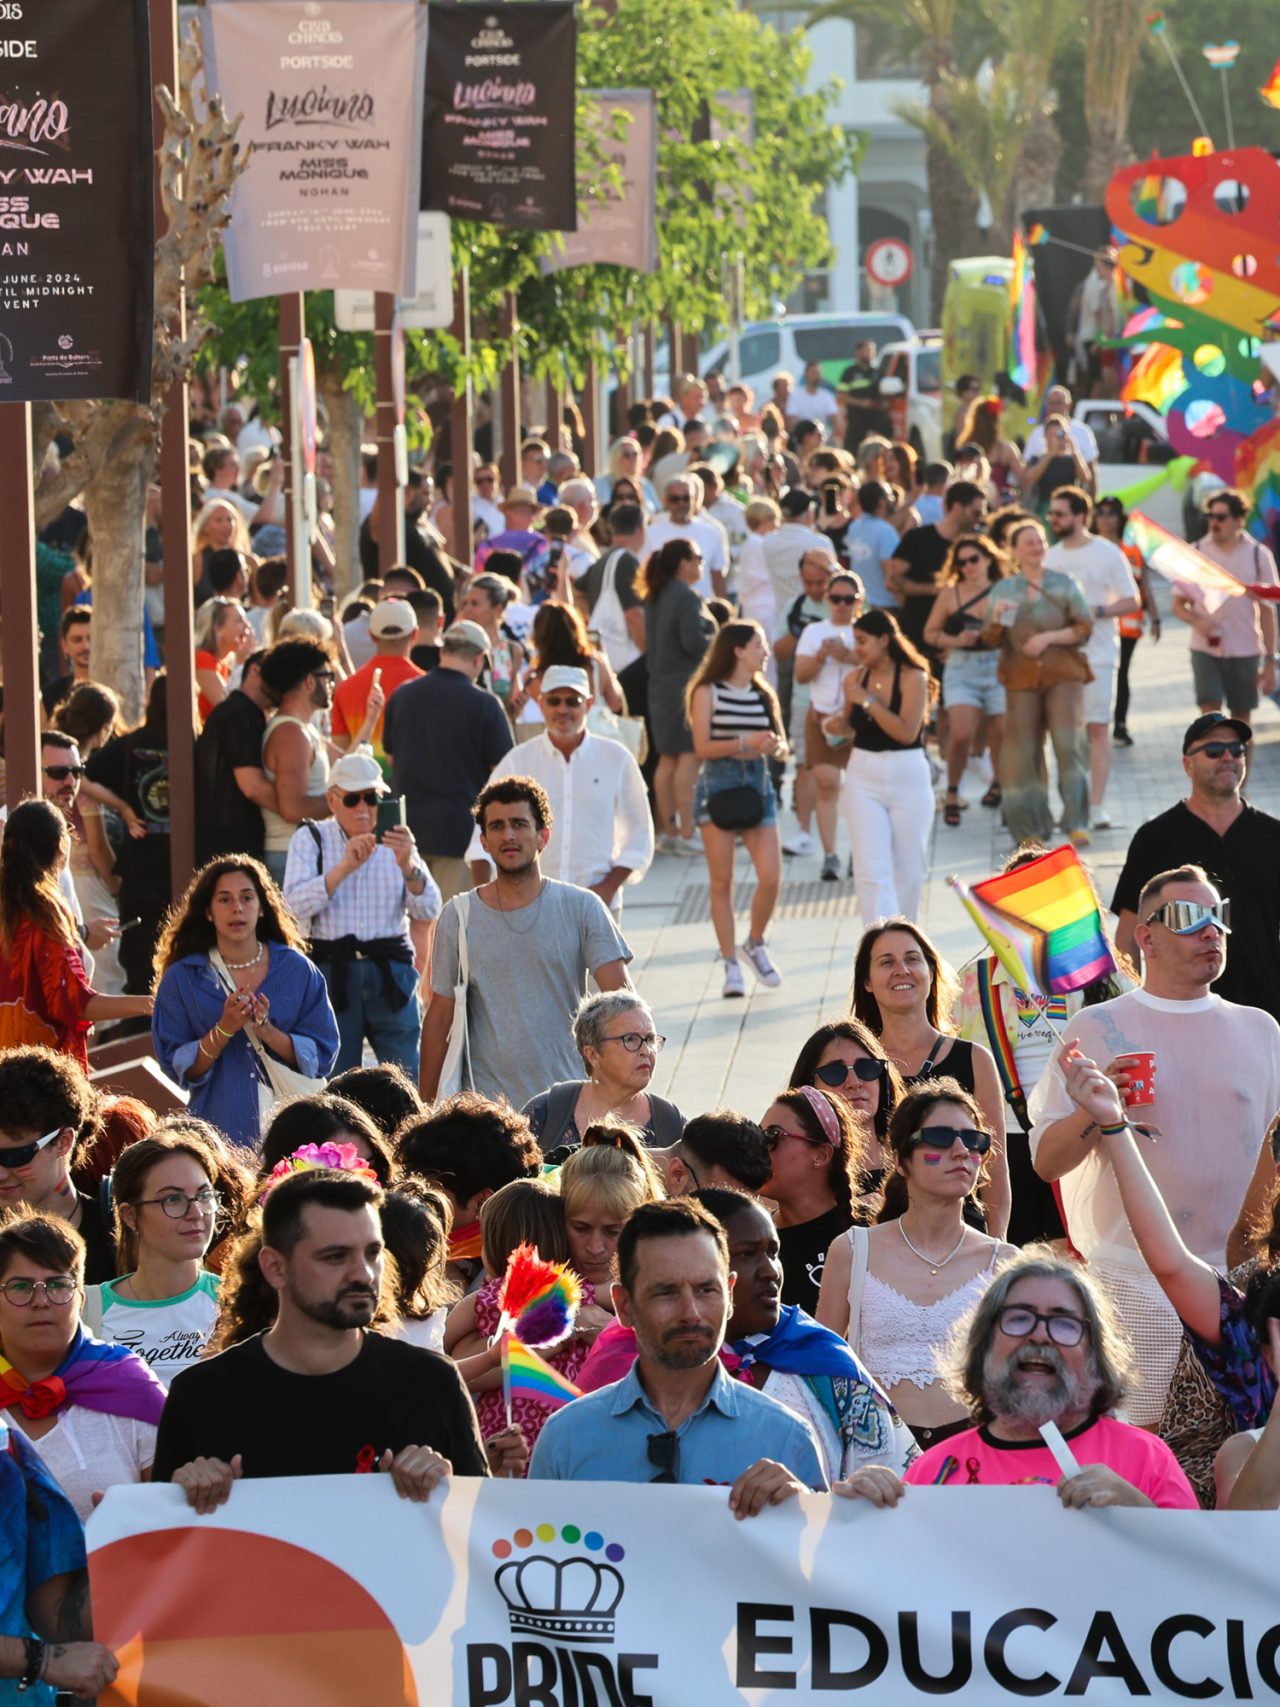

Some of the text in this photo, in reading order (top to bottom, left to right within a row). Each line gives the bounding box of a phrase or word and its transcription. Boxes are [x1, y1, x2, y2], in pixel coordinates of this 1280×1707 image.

[280, 55, 353, 69] PORTSIDE
[343, 139, 390, 151] WAH
[300, 158, 349, 169] MISS
[24, 168, 93, 185] WAH
[279, 168, 369, 181] MONIQUE
[2, 242, 29, 257] AN
[3, 274, 81, 284] JUNE 2024
[26, 286, 94, 297] MIDNIGHT
[0, 300, 40, 309] VENT
[159, 1330, 207, 1344] Alway
[467, 1642, 658, 1707] PRIDE
